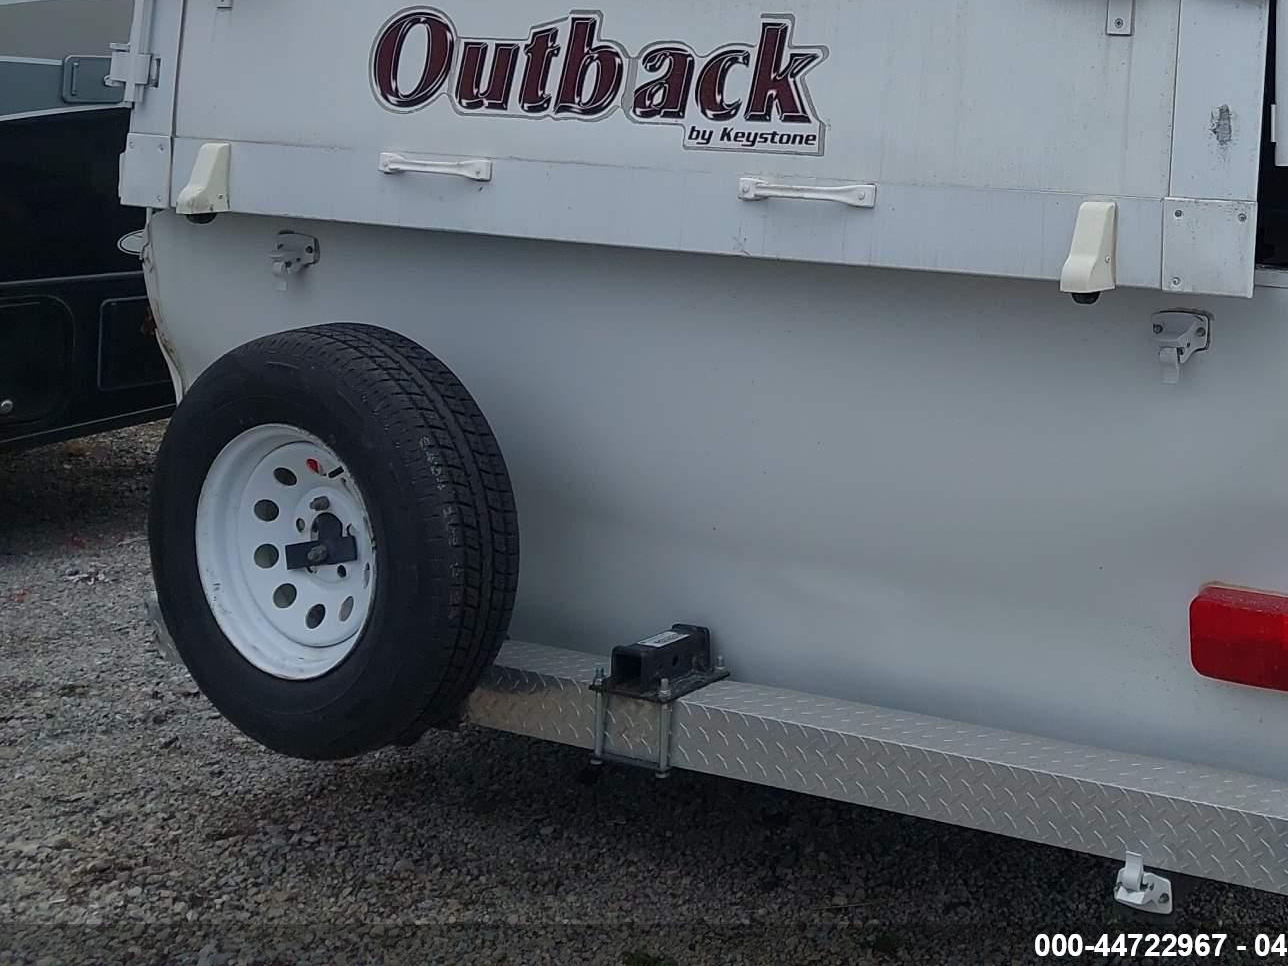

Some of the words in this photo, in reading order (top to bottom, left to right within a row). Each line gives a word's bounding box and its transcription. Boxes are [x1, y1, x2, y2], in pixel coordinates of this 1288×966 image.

[373, 10, 822, 123] Outback
[687, 125, 714, 145] by
[720, 127, 817, 147] Keystone
